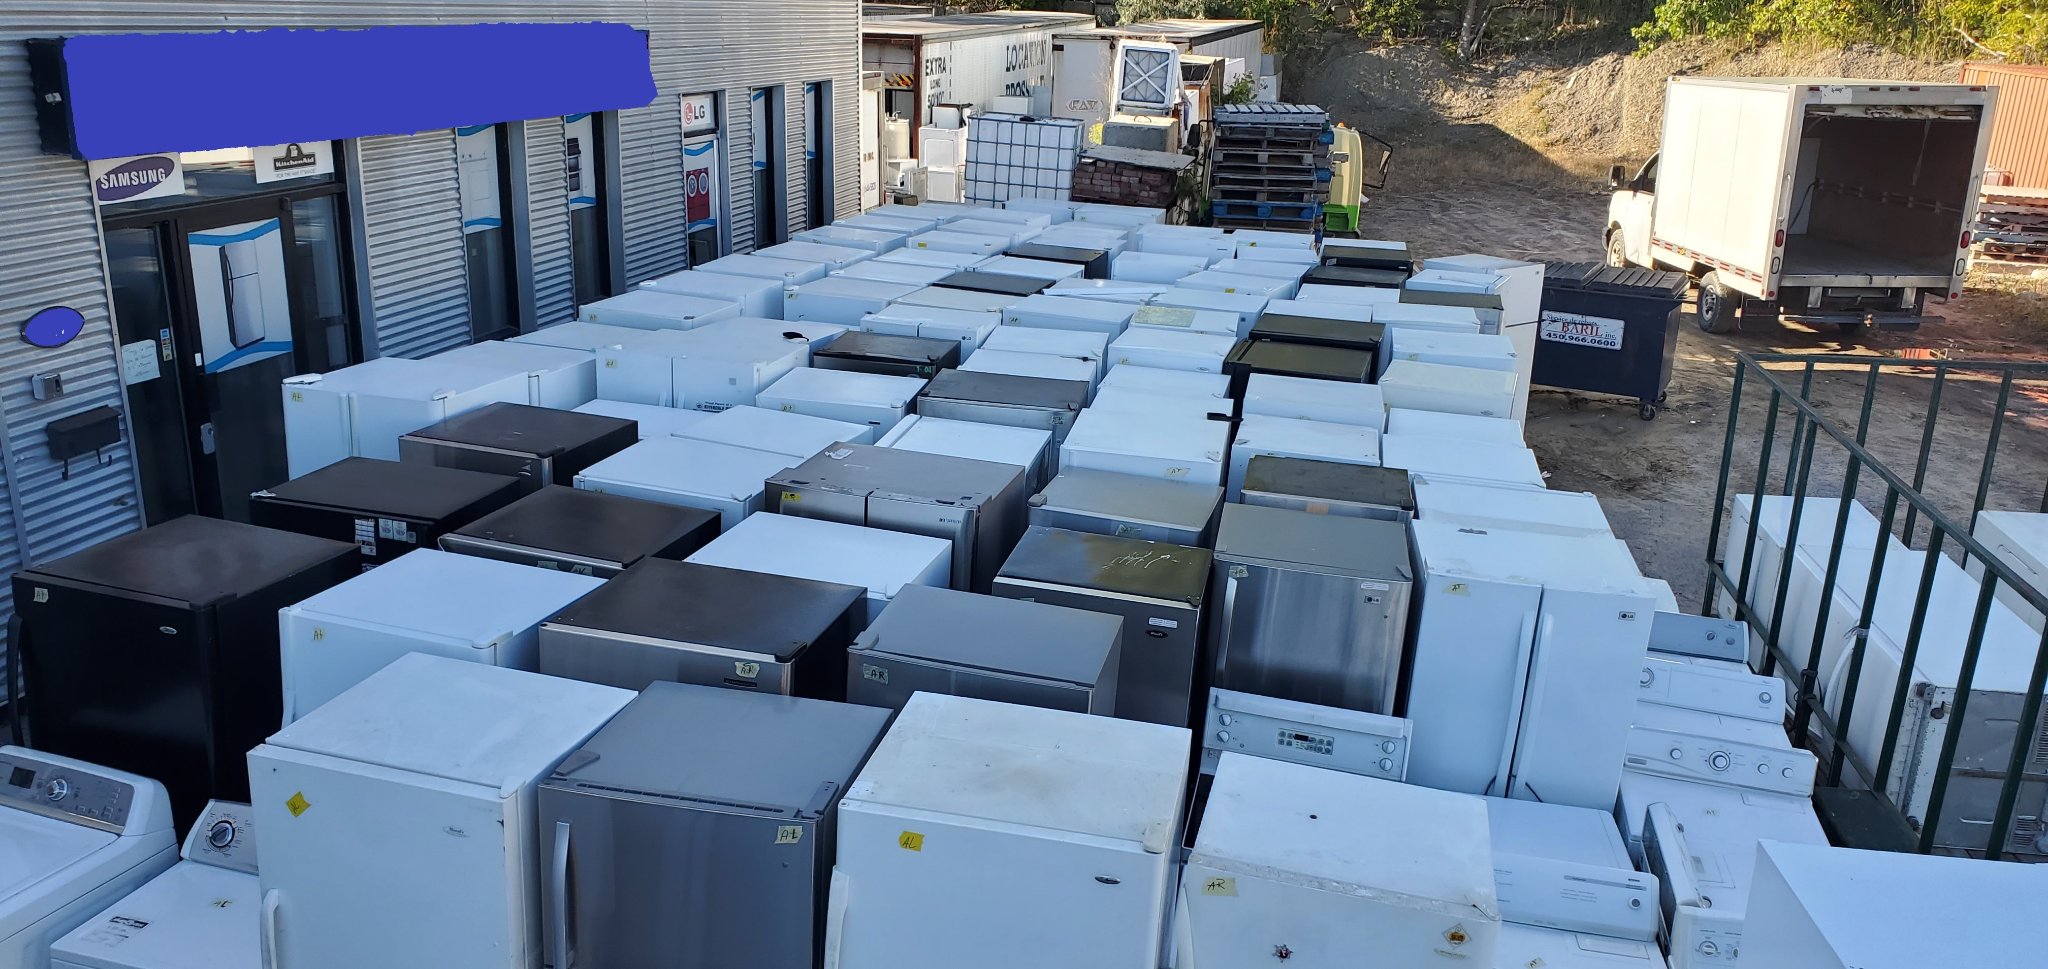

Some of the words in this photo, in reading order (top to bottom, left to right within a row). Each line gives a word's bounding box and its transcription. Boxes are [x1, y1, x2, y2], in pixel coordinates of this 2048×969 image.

[1006, 40, 1047, 72] LOCATION
[925, 56, 946, 76] EXTRA
[694, 104, 705, 120] LG
[275, 157, 315, 168] KitchenAid
[100, 167, 166, 189] SAMSUNG
[1546, 332, 1616, 347] 450.966.0600
[870, 669, 886, 681] AR
[902, 835, 916, 849] AL
[1207, 878, 1226, 891] AR
